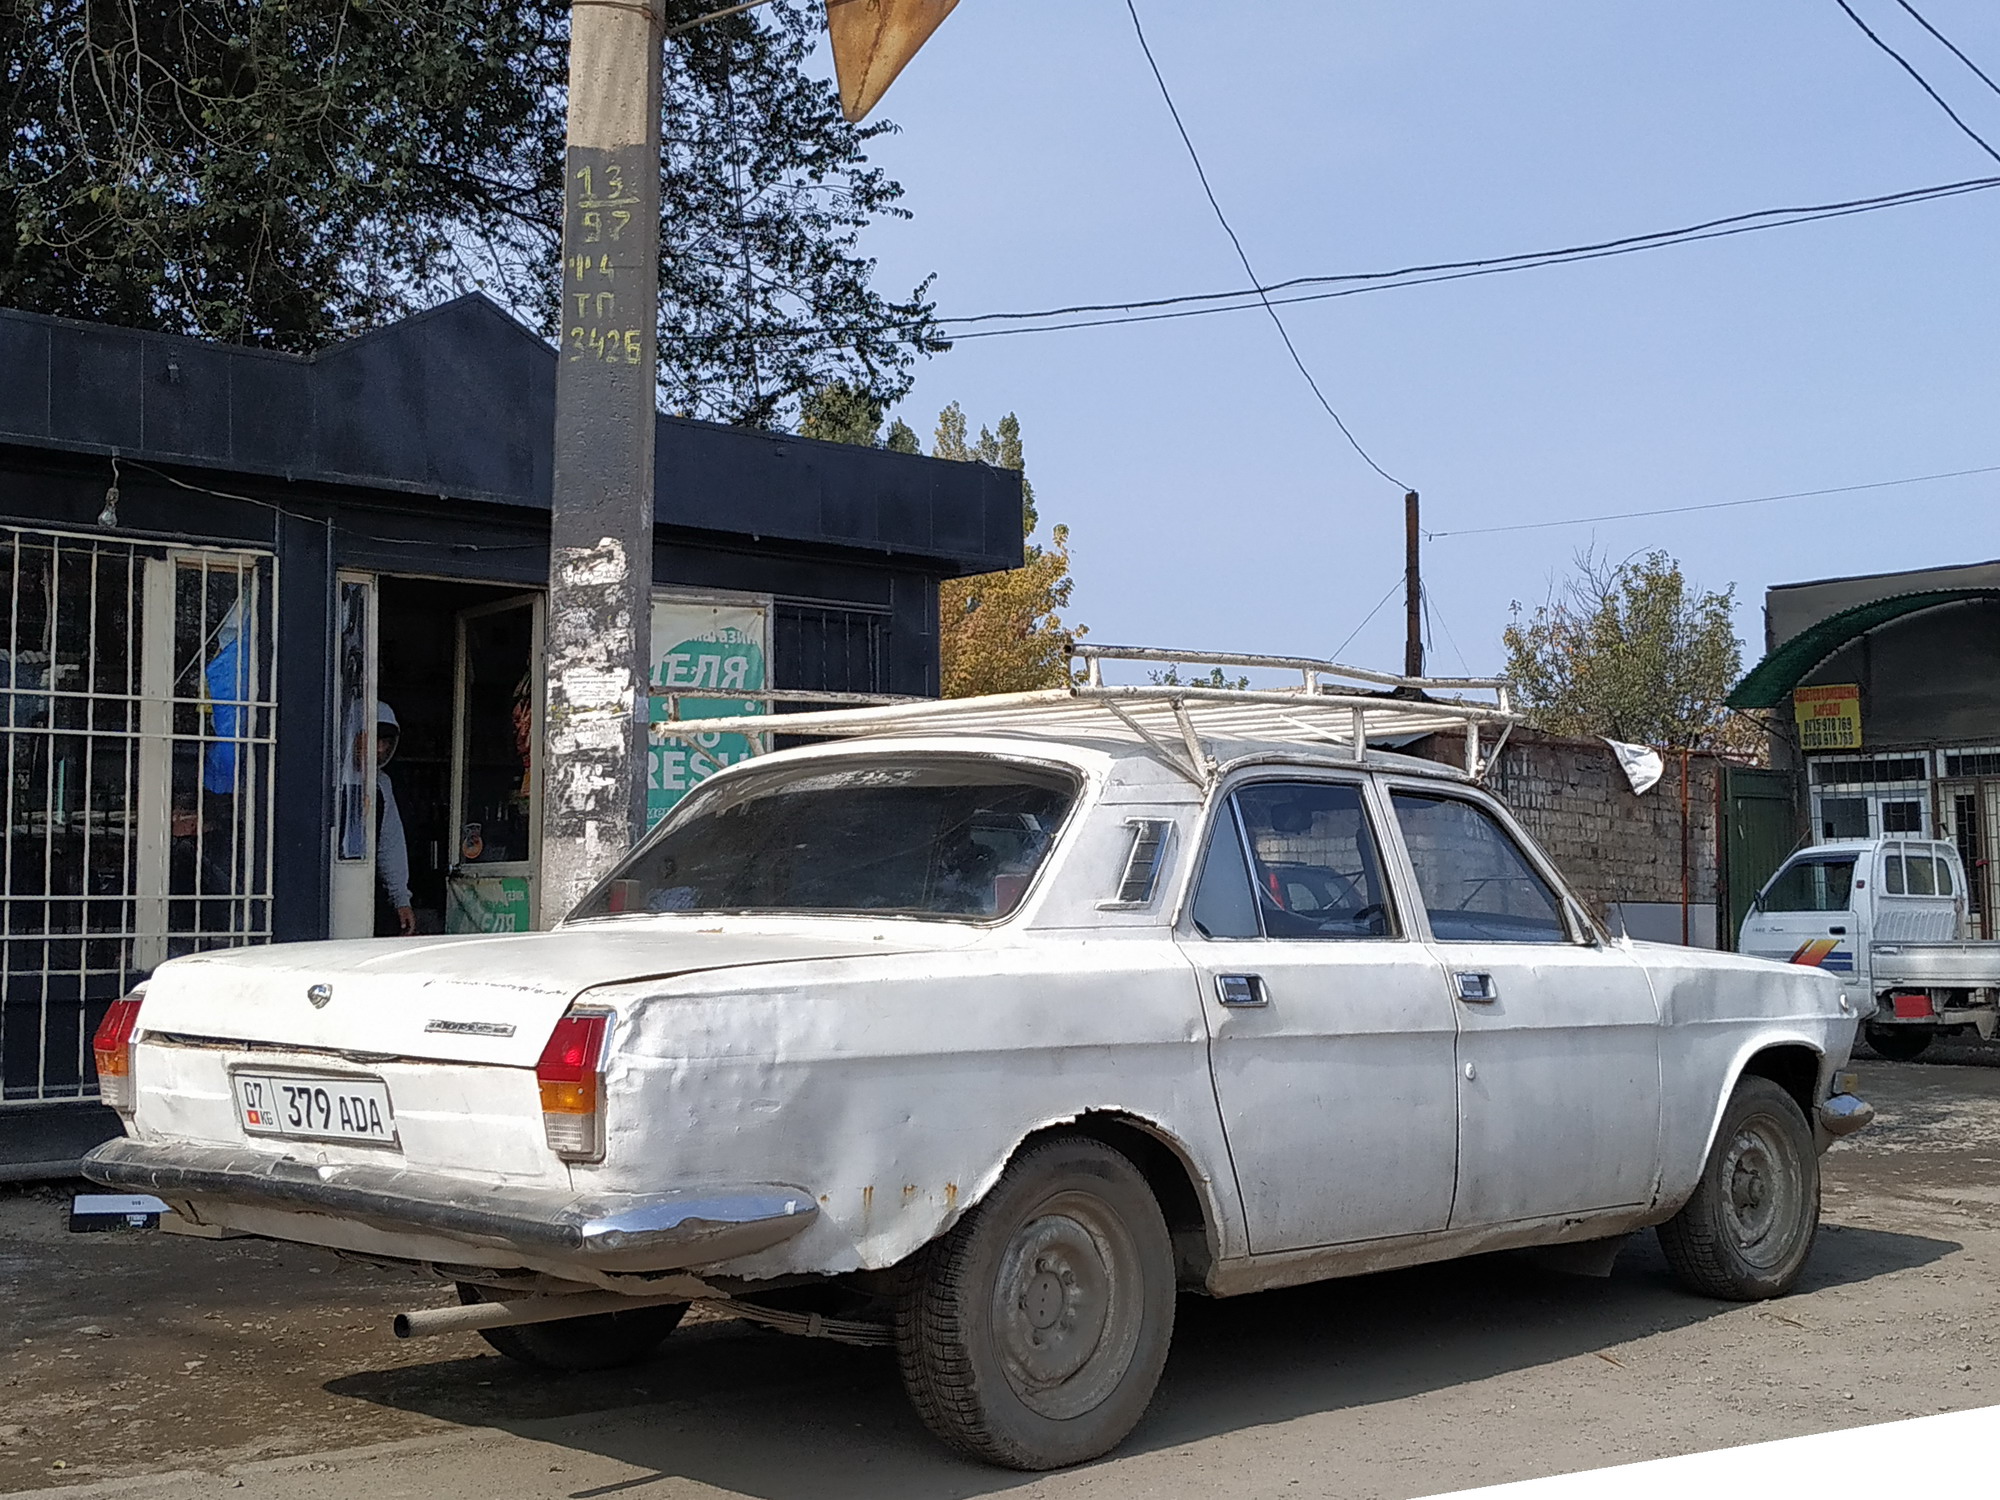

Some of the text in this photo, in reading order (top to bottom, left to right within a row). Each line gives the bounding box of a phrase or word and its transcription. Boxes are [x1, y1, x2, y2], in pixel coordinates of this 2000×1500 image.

[576, 165, 623, 199] 13
[243, 1082, 263, 1109] 07
[282, 1086, 385, 1135] 379 ADA
[260, 1110, 274, 1126] KG
